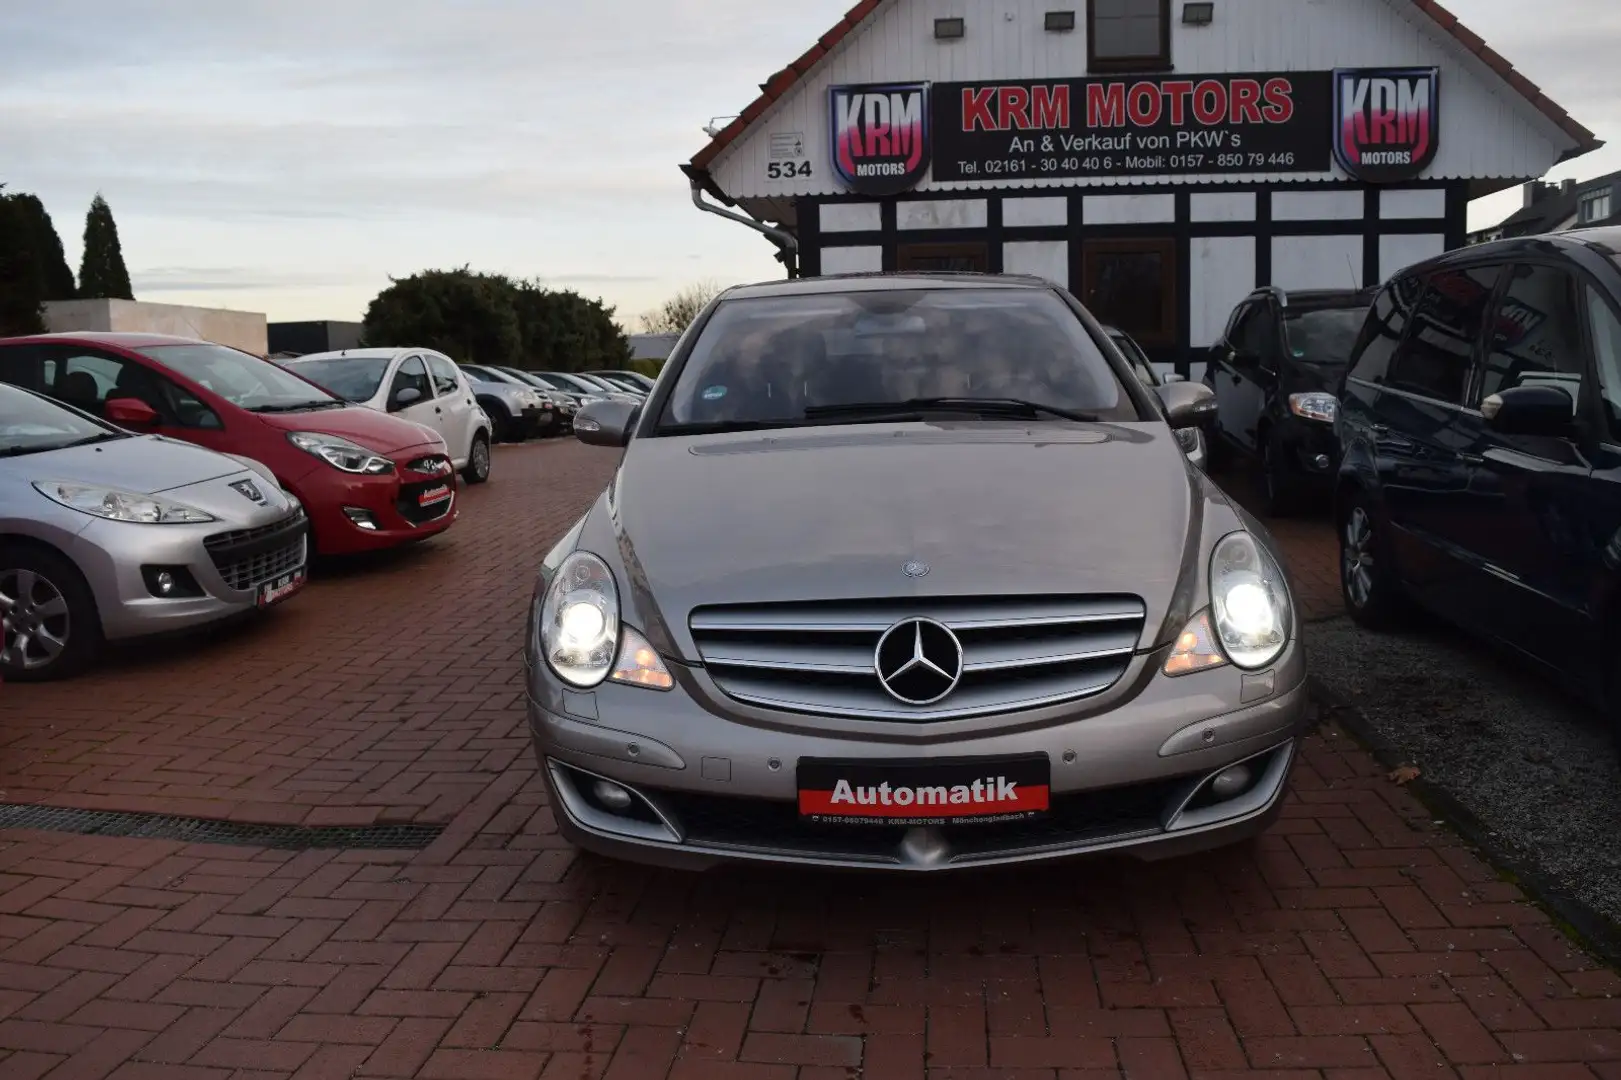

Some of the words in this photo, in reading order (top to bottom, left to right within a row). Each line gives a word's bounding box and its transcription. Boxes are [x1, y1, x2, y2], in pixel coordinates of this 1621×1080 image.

[962, 85, 1070, 131] KRM
[1087, 78, 1294, 127] MOTORS
[1343, 77, 1429, 162] KRM
[837, 93, 923, 172] KRM
[1009, 136, 1034, 152] An
[1041, 135, 1054, 152] &
[1060, 132, 1132, 150] Verkauf
[1137, 135, 1170, 149] von
[958, 160, 981, 174] Tel.
[985, 159, 1026, 173] 02161
[1041, 158, 1057, 171] 30
[1061, 158, 1078, 170] 40
[1082, 157, 1099, 170] 40
[1103, 156, 1112, 169] 6
[1126, 155, 1166, 168] Mobil:
[1170, 154, 1204, 167] 0157
[1217, 154, 1243, 166] 850
[1248, 153, 1265, 166] 79
[1268, 152, 1294, 165] 446
[1361, 151, 1412, 165] MOTORS
[767, 160, 812, 179] 534
[857, 162, 905, 177] MOTORS
[831, 776, 1018, 805] Automatik
